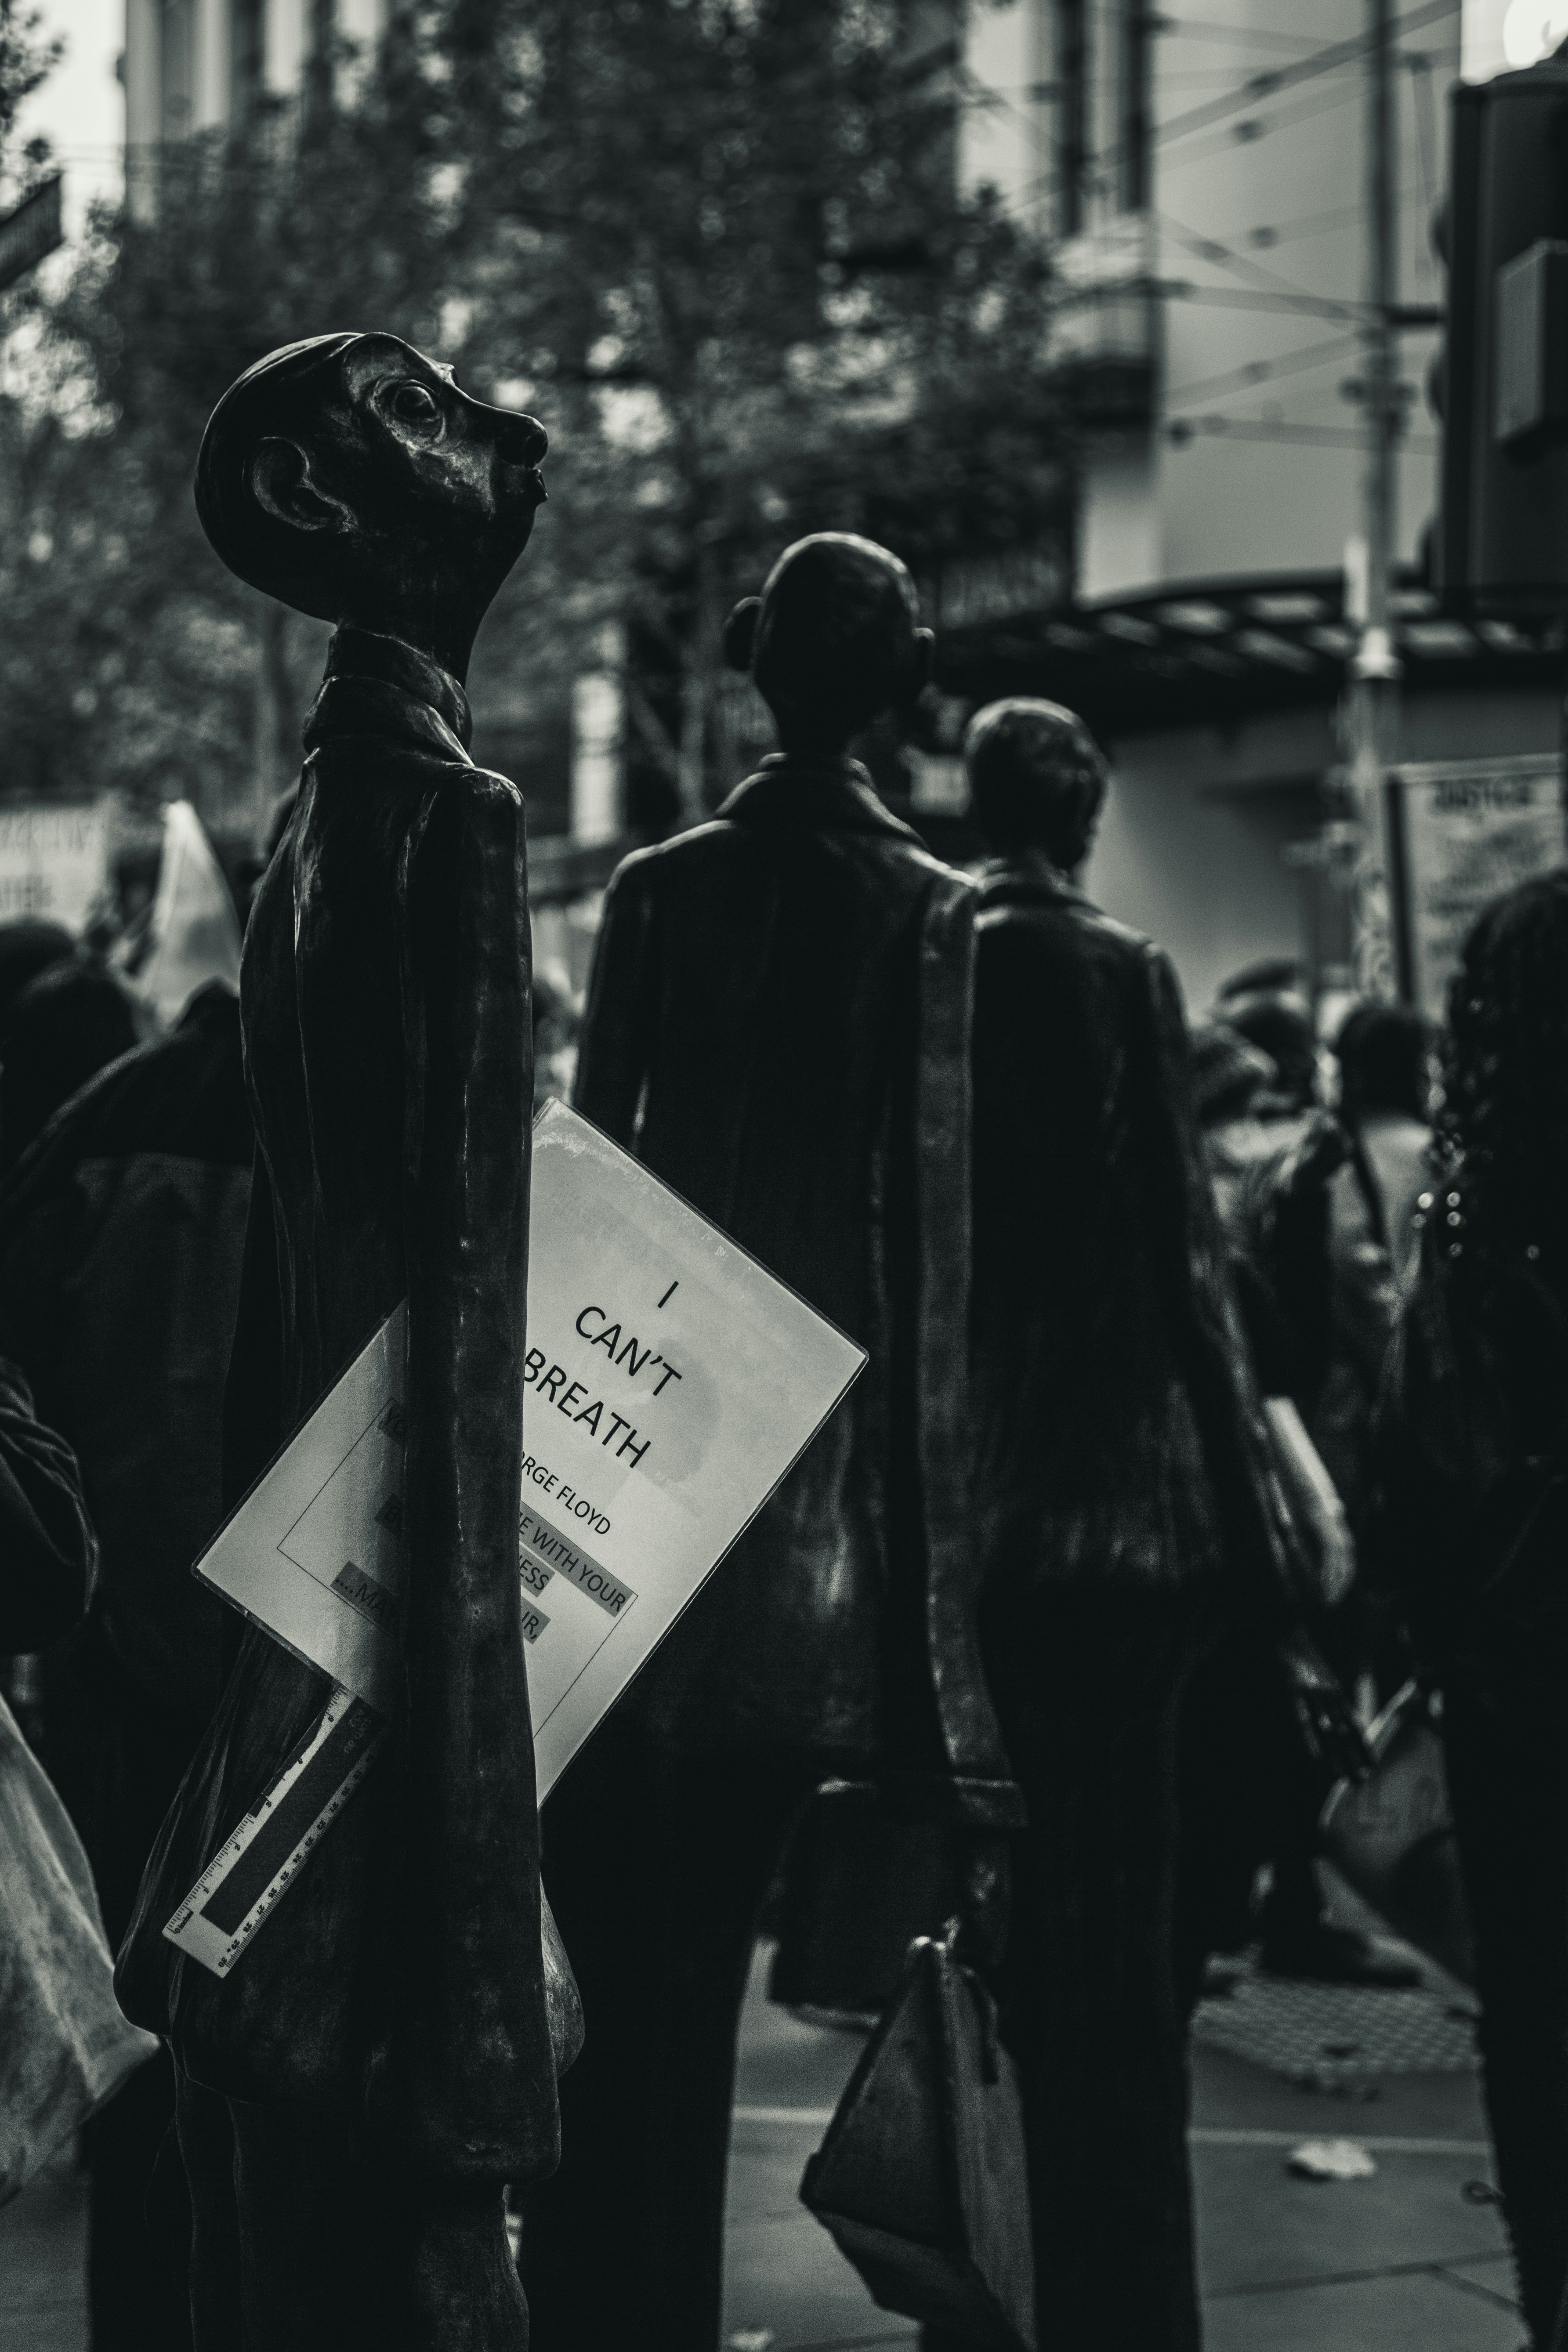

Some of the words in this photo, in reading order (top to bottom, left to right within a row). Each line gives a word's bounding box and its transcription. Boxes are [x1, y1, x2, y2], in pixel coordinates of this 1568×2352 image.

[657, 1281, 679, 1308] I
[576, 1306, 682, 1396] CAN'T
[524, 1347, 652, 1469] BREATH
[521, 1451, 559, 1493] RGE
[556, 1485, 610, 1534] FLOYD
[519, 1554, 549, 1590] ESS
[532, 1527, 579, 1573] WITH
[579, 1565, 626, 1612] YOUR
[341, 1786, 350, 1796] 20
[330, 1802, 339, 1813] 21
[317, 1820, 326, 1830] 22
[305, 1836, 314, 1847] 23
[293, 1853, 302, 1864] 24
[280, 1870, 290, 1881] 25
[268, 1887, 277, 1898] 26
[257, 1904, 265, 1915] 27
[177, 1910, 194, 1929] inches
[243, 1922, 252, 1932] 28
[231, 1939, 240, 1950] 29
[218, 1957, 227, 1968] 30
